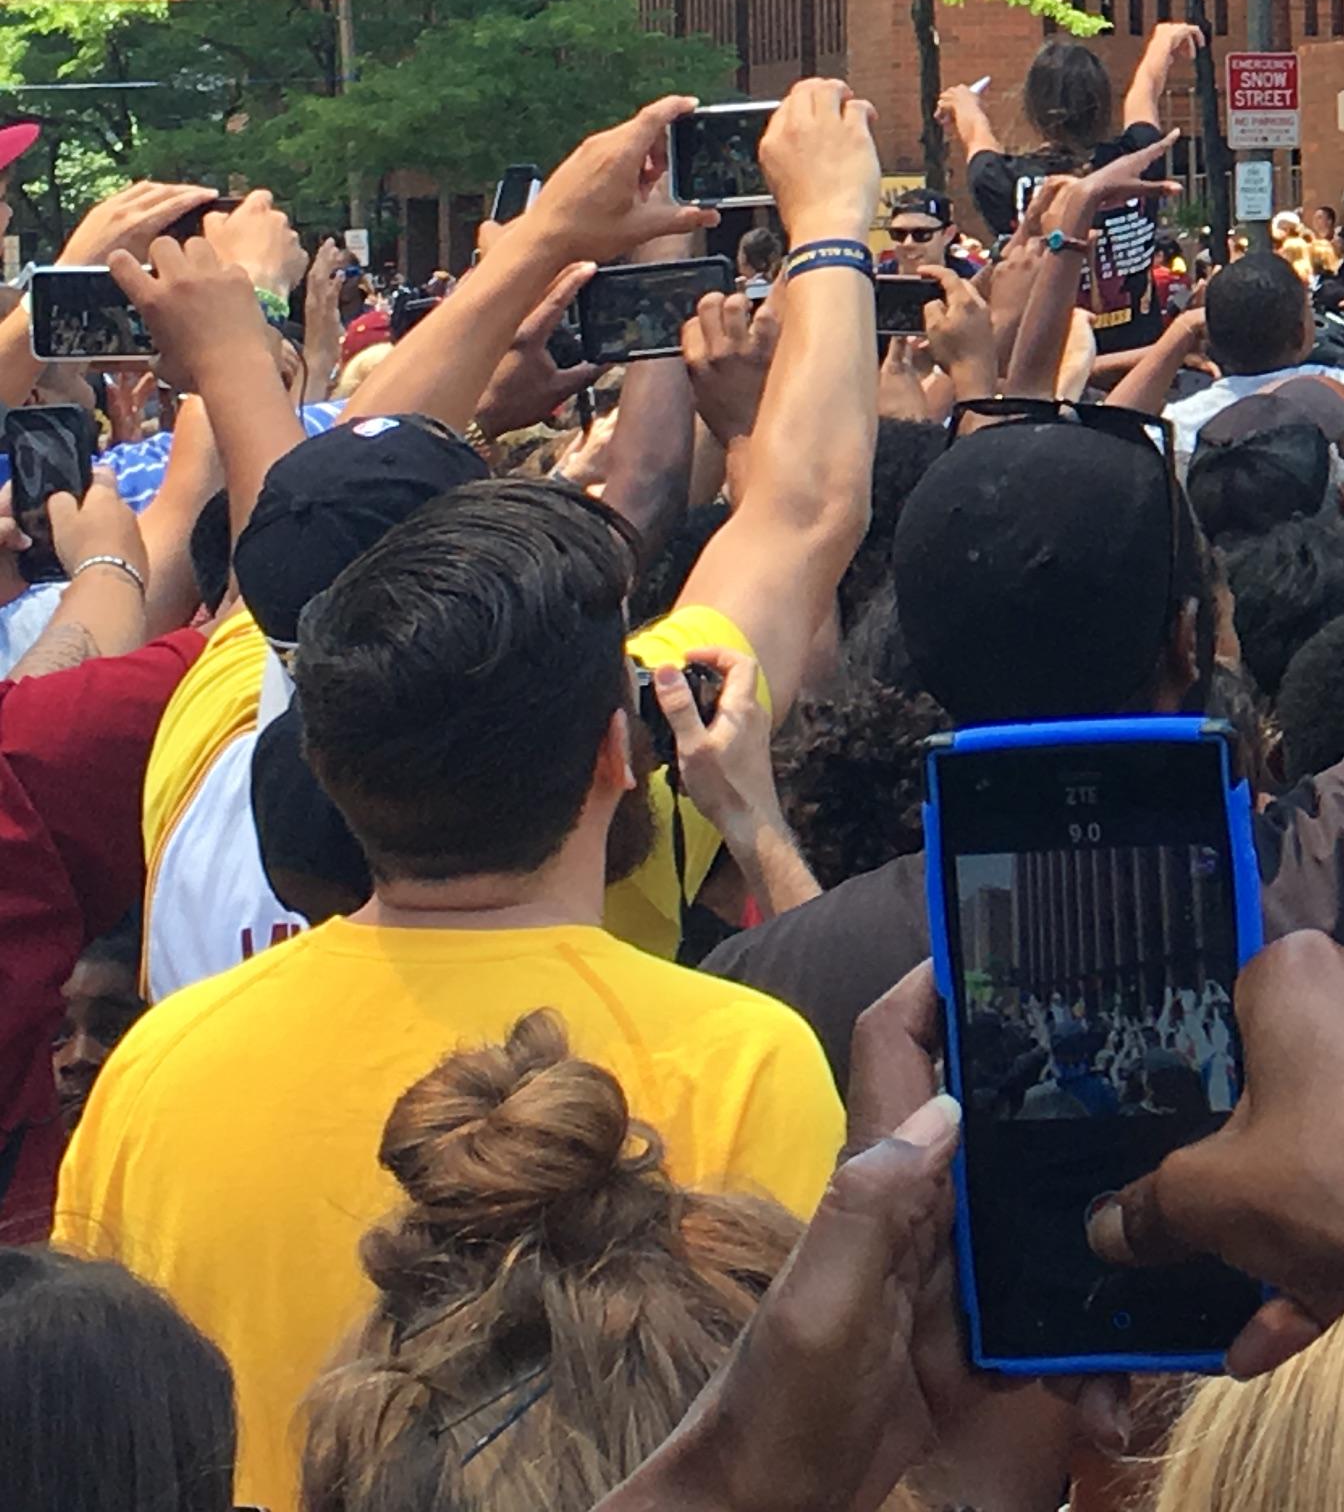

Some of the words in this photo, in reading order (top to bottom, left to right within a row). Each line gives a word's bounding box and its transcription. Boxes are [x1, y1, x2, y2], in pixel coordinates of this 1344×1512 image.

[1231, 59, 1295, 70] EMERGENCY
[1240, 72, 1287, 88] SNOW
[1234, 90, 1293, 106] STREET
[1251, 116, 1295, 126] PARKING
[1065, 786, 1097, 805] ZTE
